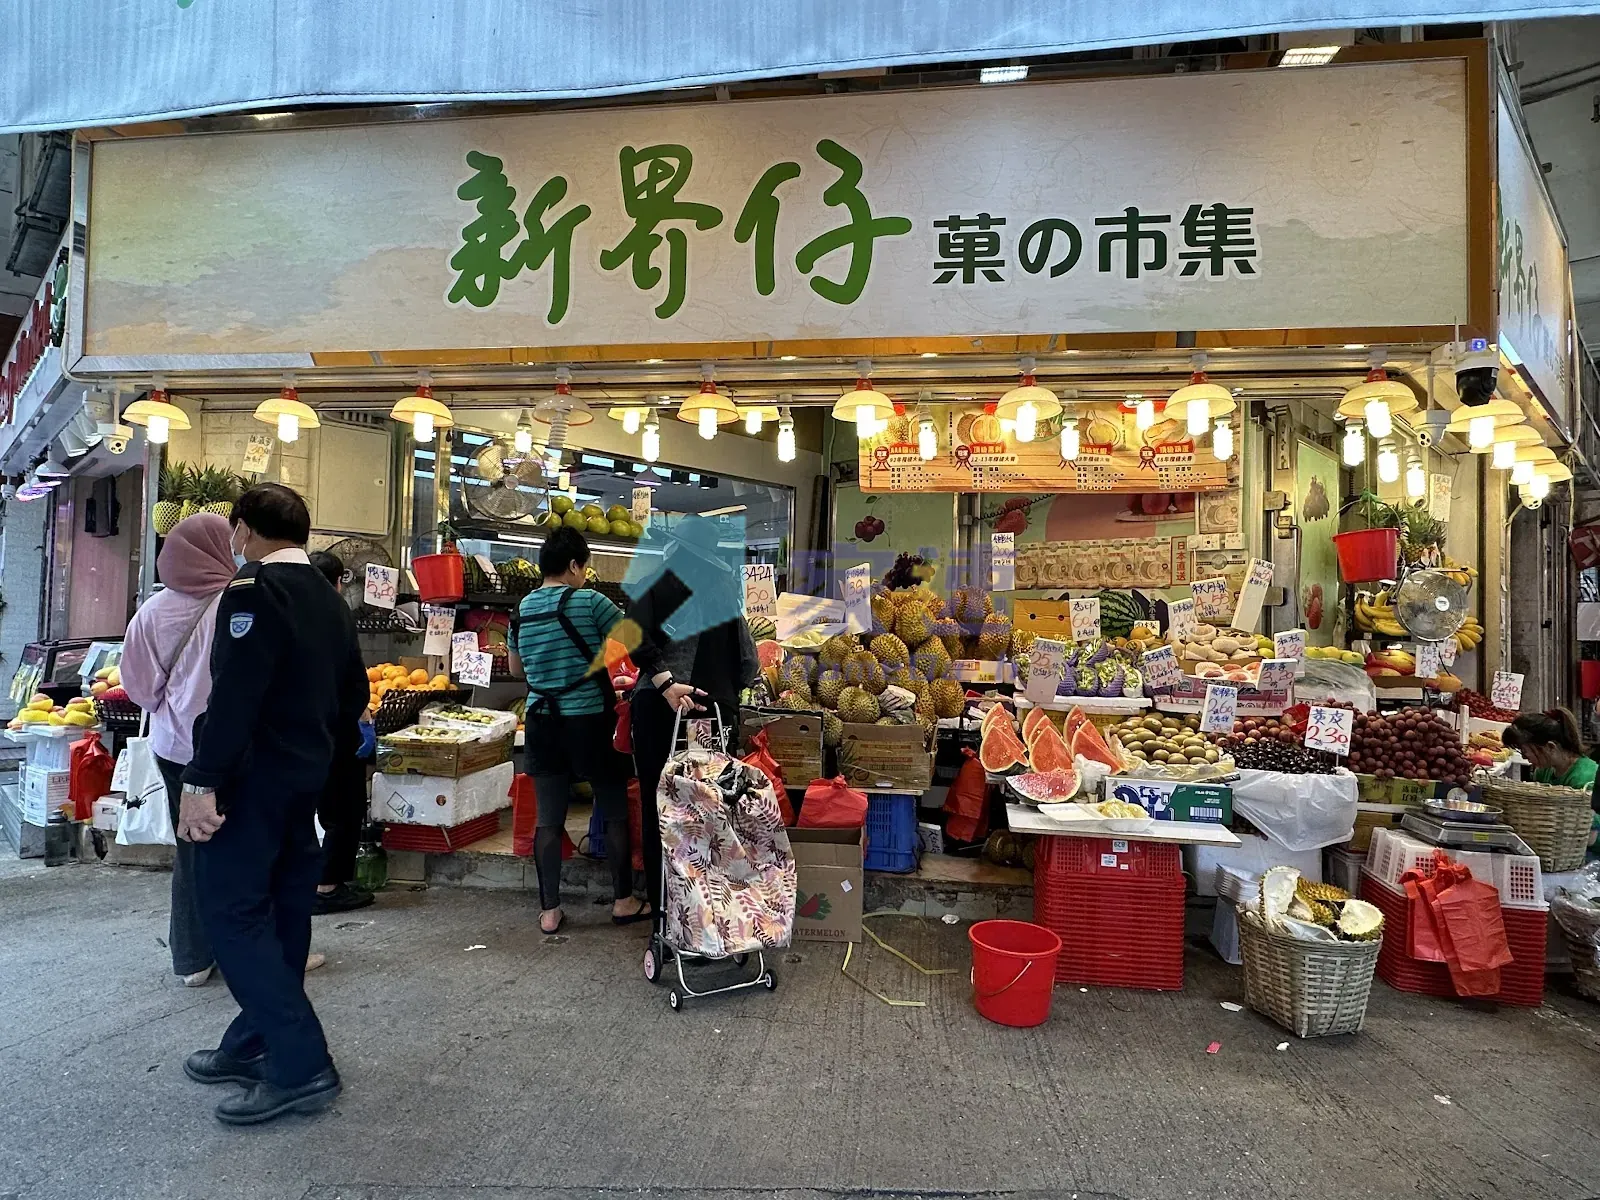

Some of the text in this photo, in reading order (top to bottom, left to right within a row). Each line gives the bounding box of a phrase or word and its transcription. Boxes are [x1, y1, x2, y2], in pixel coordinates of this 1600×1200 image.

[447, 138, 912, 324] 新界仔
[932, 203, 1257, 285] 菓の市集
[1175, 541, 1187, 582] 日本直送
[1312, 708, 1346, 729] 黃皮
